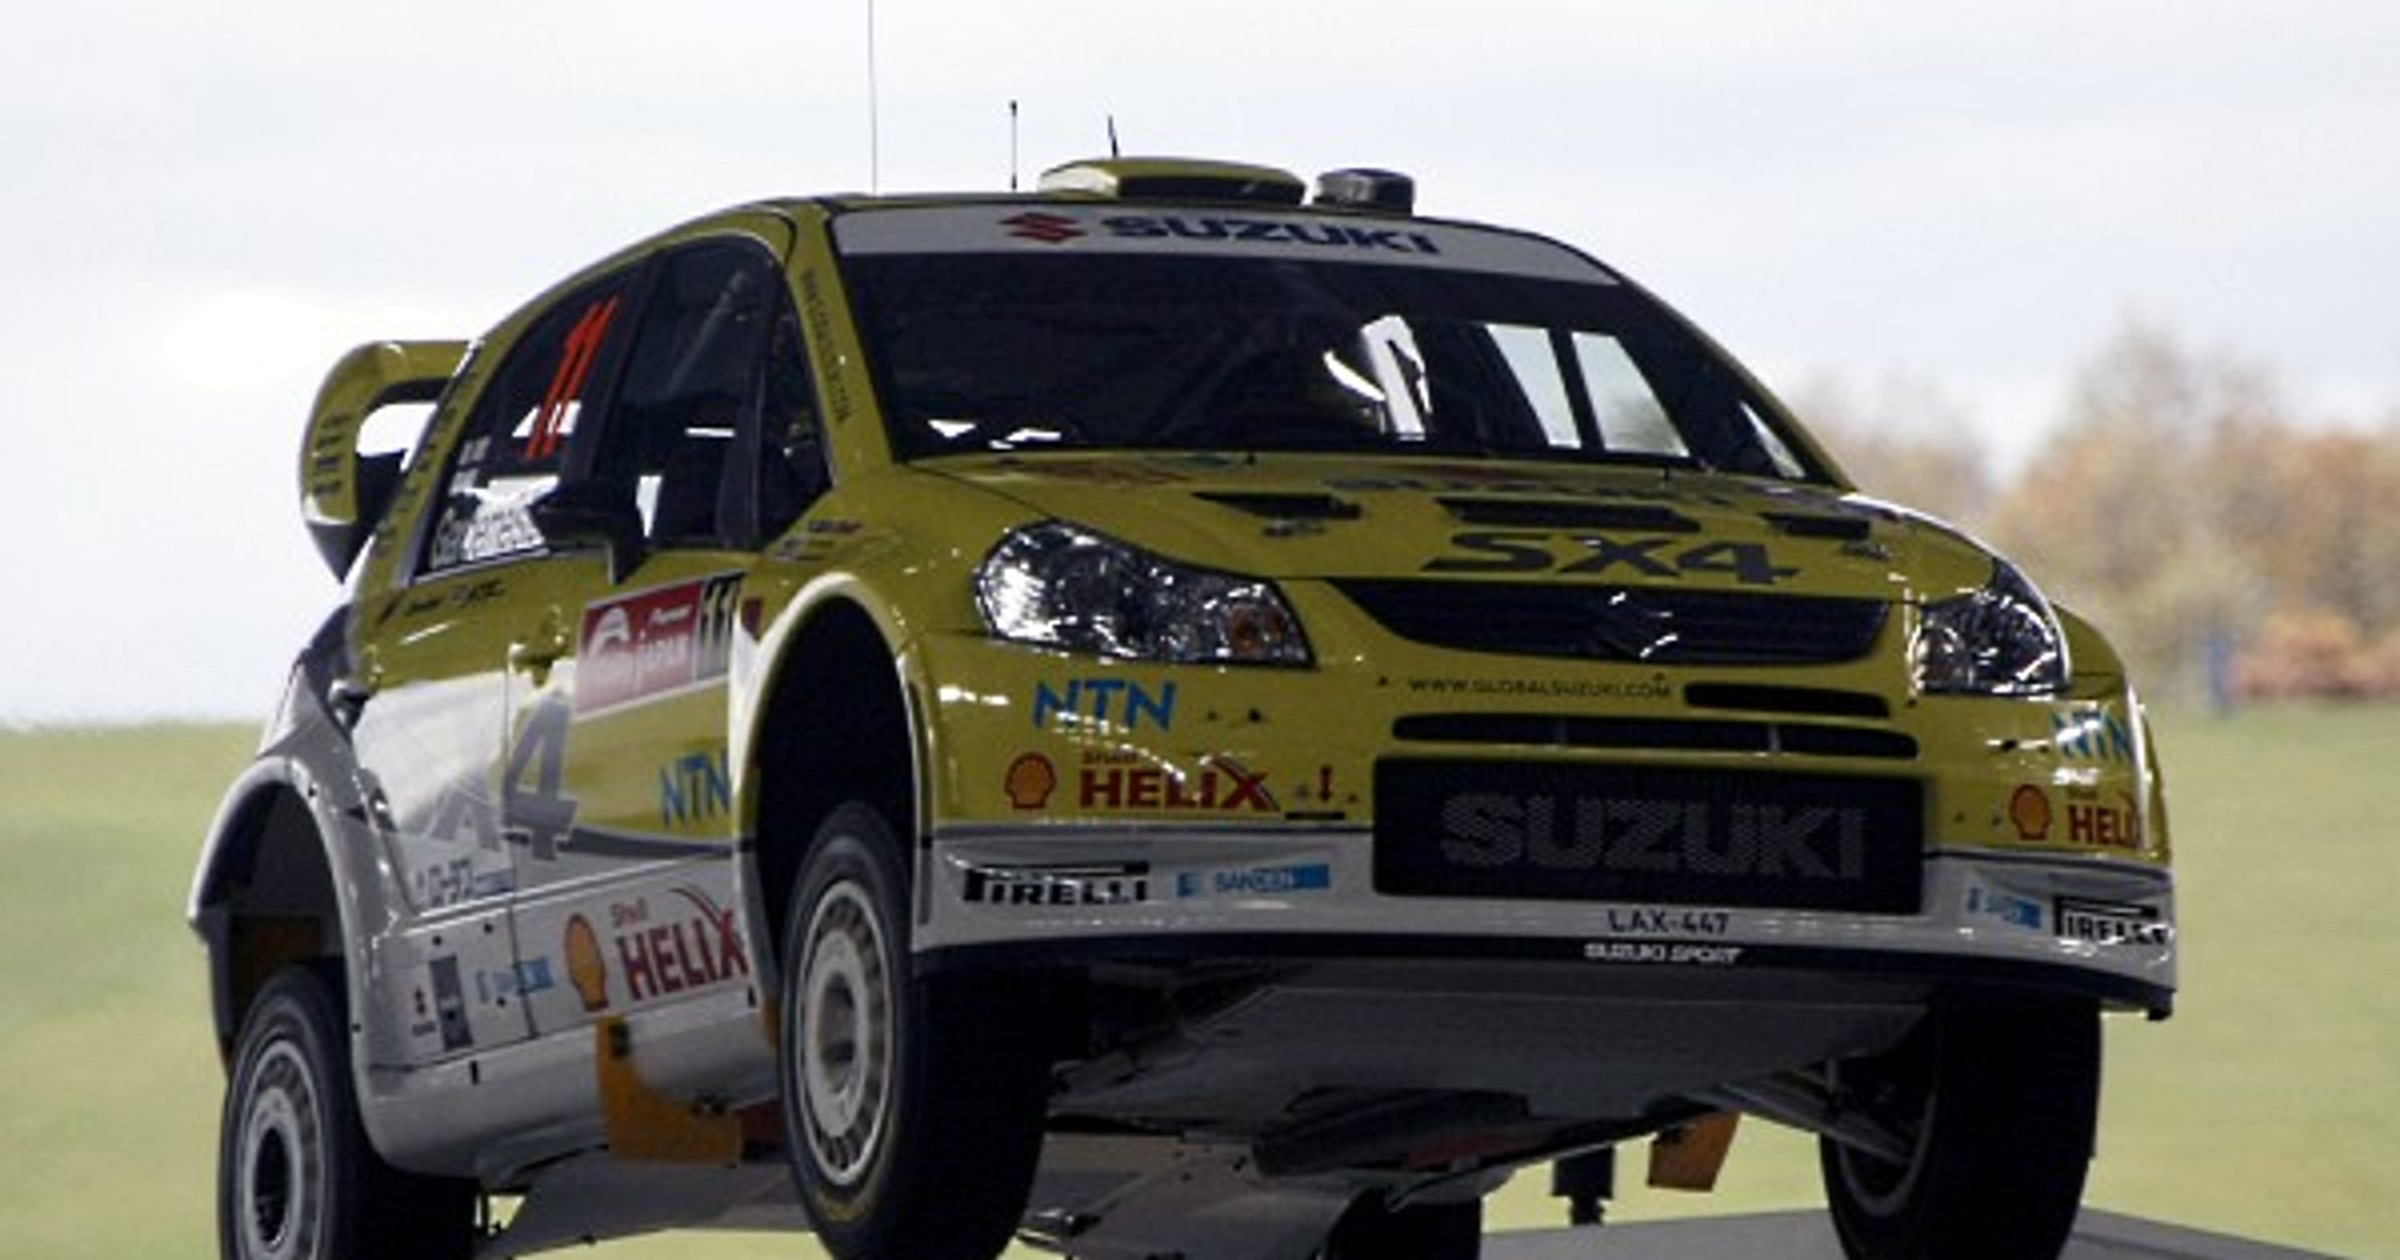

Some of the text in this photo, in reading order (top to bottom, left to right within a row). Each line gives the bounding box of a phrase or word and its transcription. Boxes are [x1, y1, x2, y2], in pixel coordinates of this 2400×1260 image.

[1102, 214, 1440, 255] SUZUKI
[527, 296, 618, 460] 11
[1420, 532, 1798, 586] SX4
[1034, 678, 1177, 731] NTN
[659, 745, 734, 827] NTN
[1078, 754, 1282, 812] HELIX
[1440, 793, 1866, 880] SUZUKI
[962, 861, 1149, 905] PIRELLI
[615, 892, 750, 1001] HELIX
[1607, 908, 1730, 934] LAX-447
[1584, 943, 1742, 964] SUZUKI SPORT
